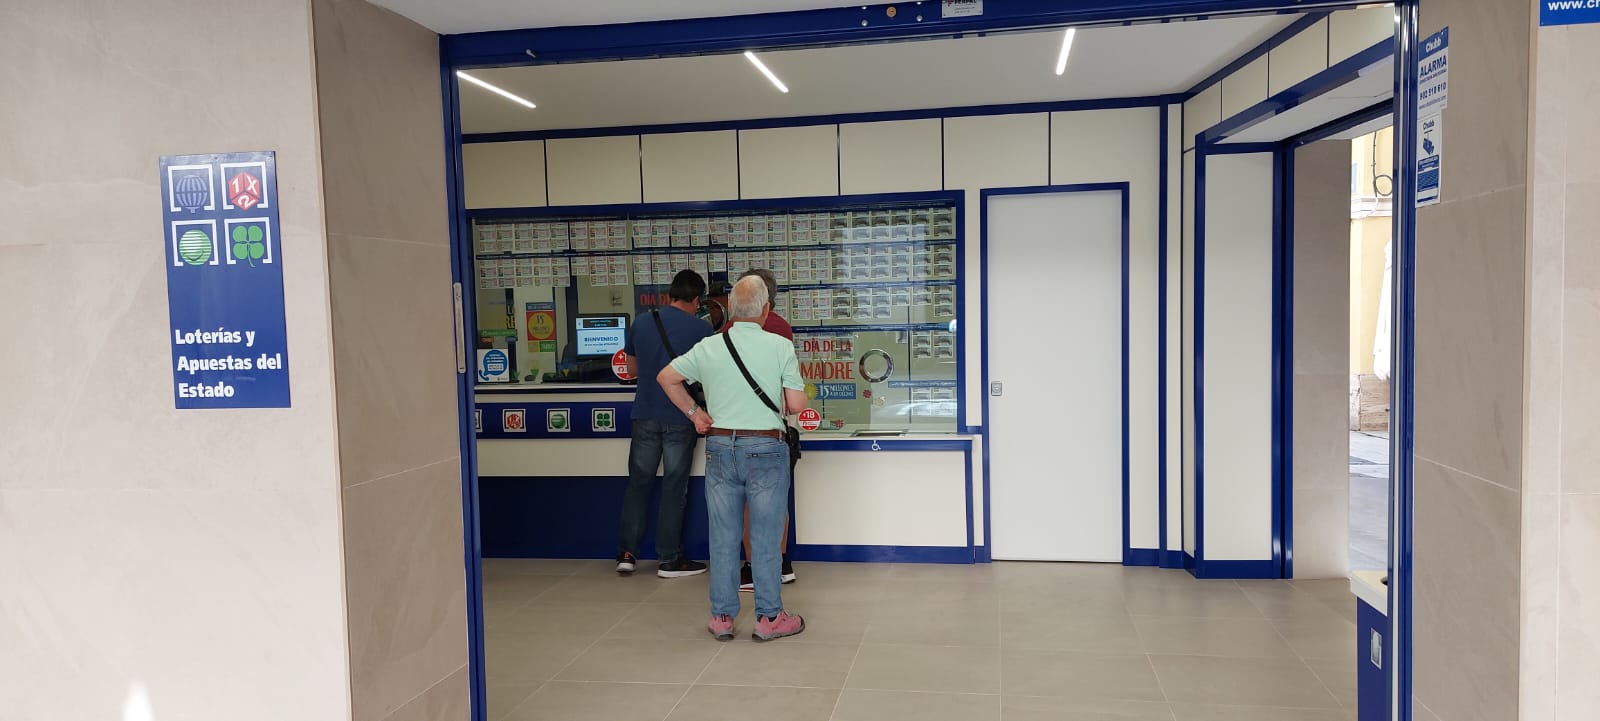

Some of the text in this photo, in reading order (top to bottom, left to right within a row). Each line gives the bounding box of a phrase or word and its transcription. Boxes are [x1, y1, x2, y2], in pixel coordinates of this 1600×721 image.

[1425, 37, 1442, 53] Chubb
[1419, 54, 1447, 78] ALARMA
[1422, 120, 1435, 131] Chubb
[175, 327, 256, 347] Loterías y
[803, 337, 851, 353] DÍA DE LA
[177, 353, 282, 374] Apuestas del
[801, 361, 856, 380] MADRE
[178, 381, 235, 399] Estado
[819, 384, 830, 399] 15
[802, 411, 815, 419] +18
